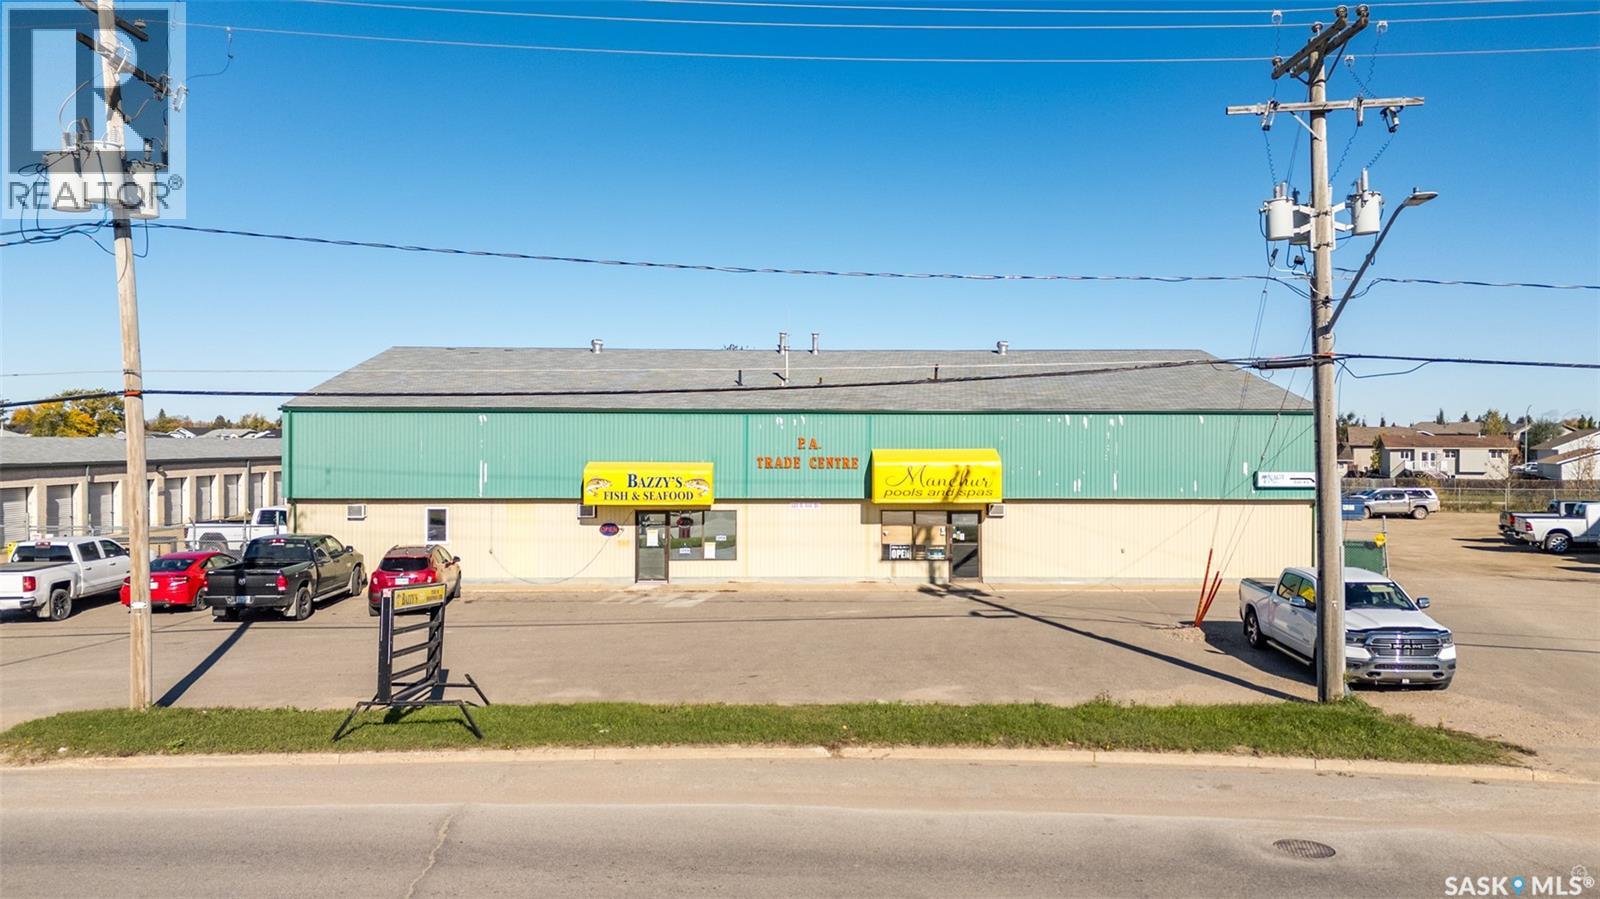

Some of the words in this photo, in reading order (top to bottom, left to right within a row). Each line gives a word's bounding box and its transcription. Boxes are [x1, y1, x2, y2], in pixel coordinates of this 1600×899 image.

[757, 456, 800, 469] TRADE
[808, 456, 859, 469] CENTRE
[885, 465, 993, 488] Manchur
[603, 491, 628, 501] FISH
[631, 491, 640, 501] &
[643, 491, 694, 501] SEAFOOD
[883, 488, 923, 498] pools
[927, 488, 955, 497] and
[957, 489, 993, 498] spas
[891, 549, 911, 559] OPEN
